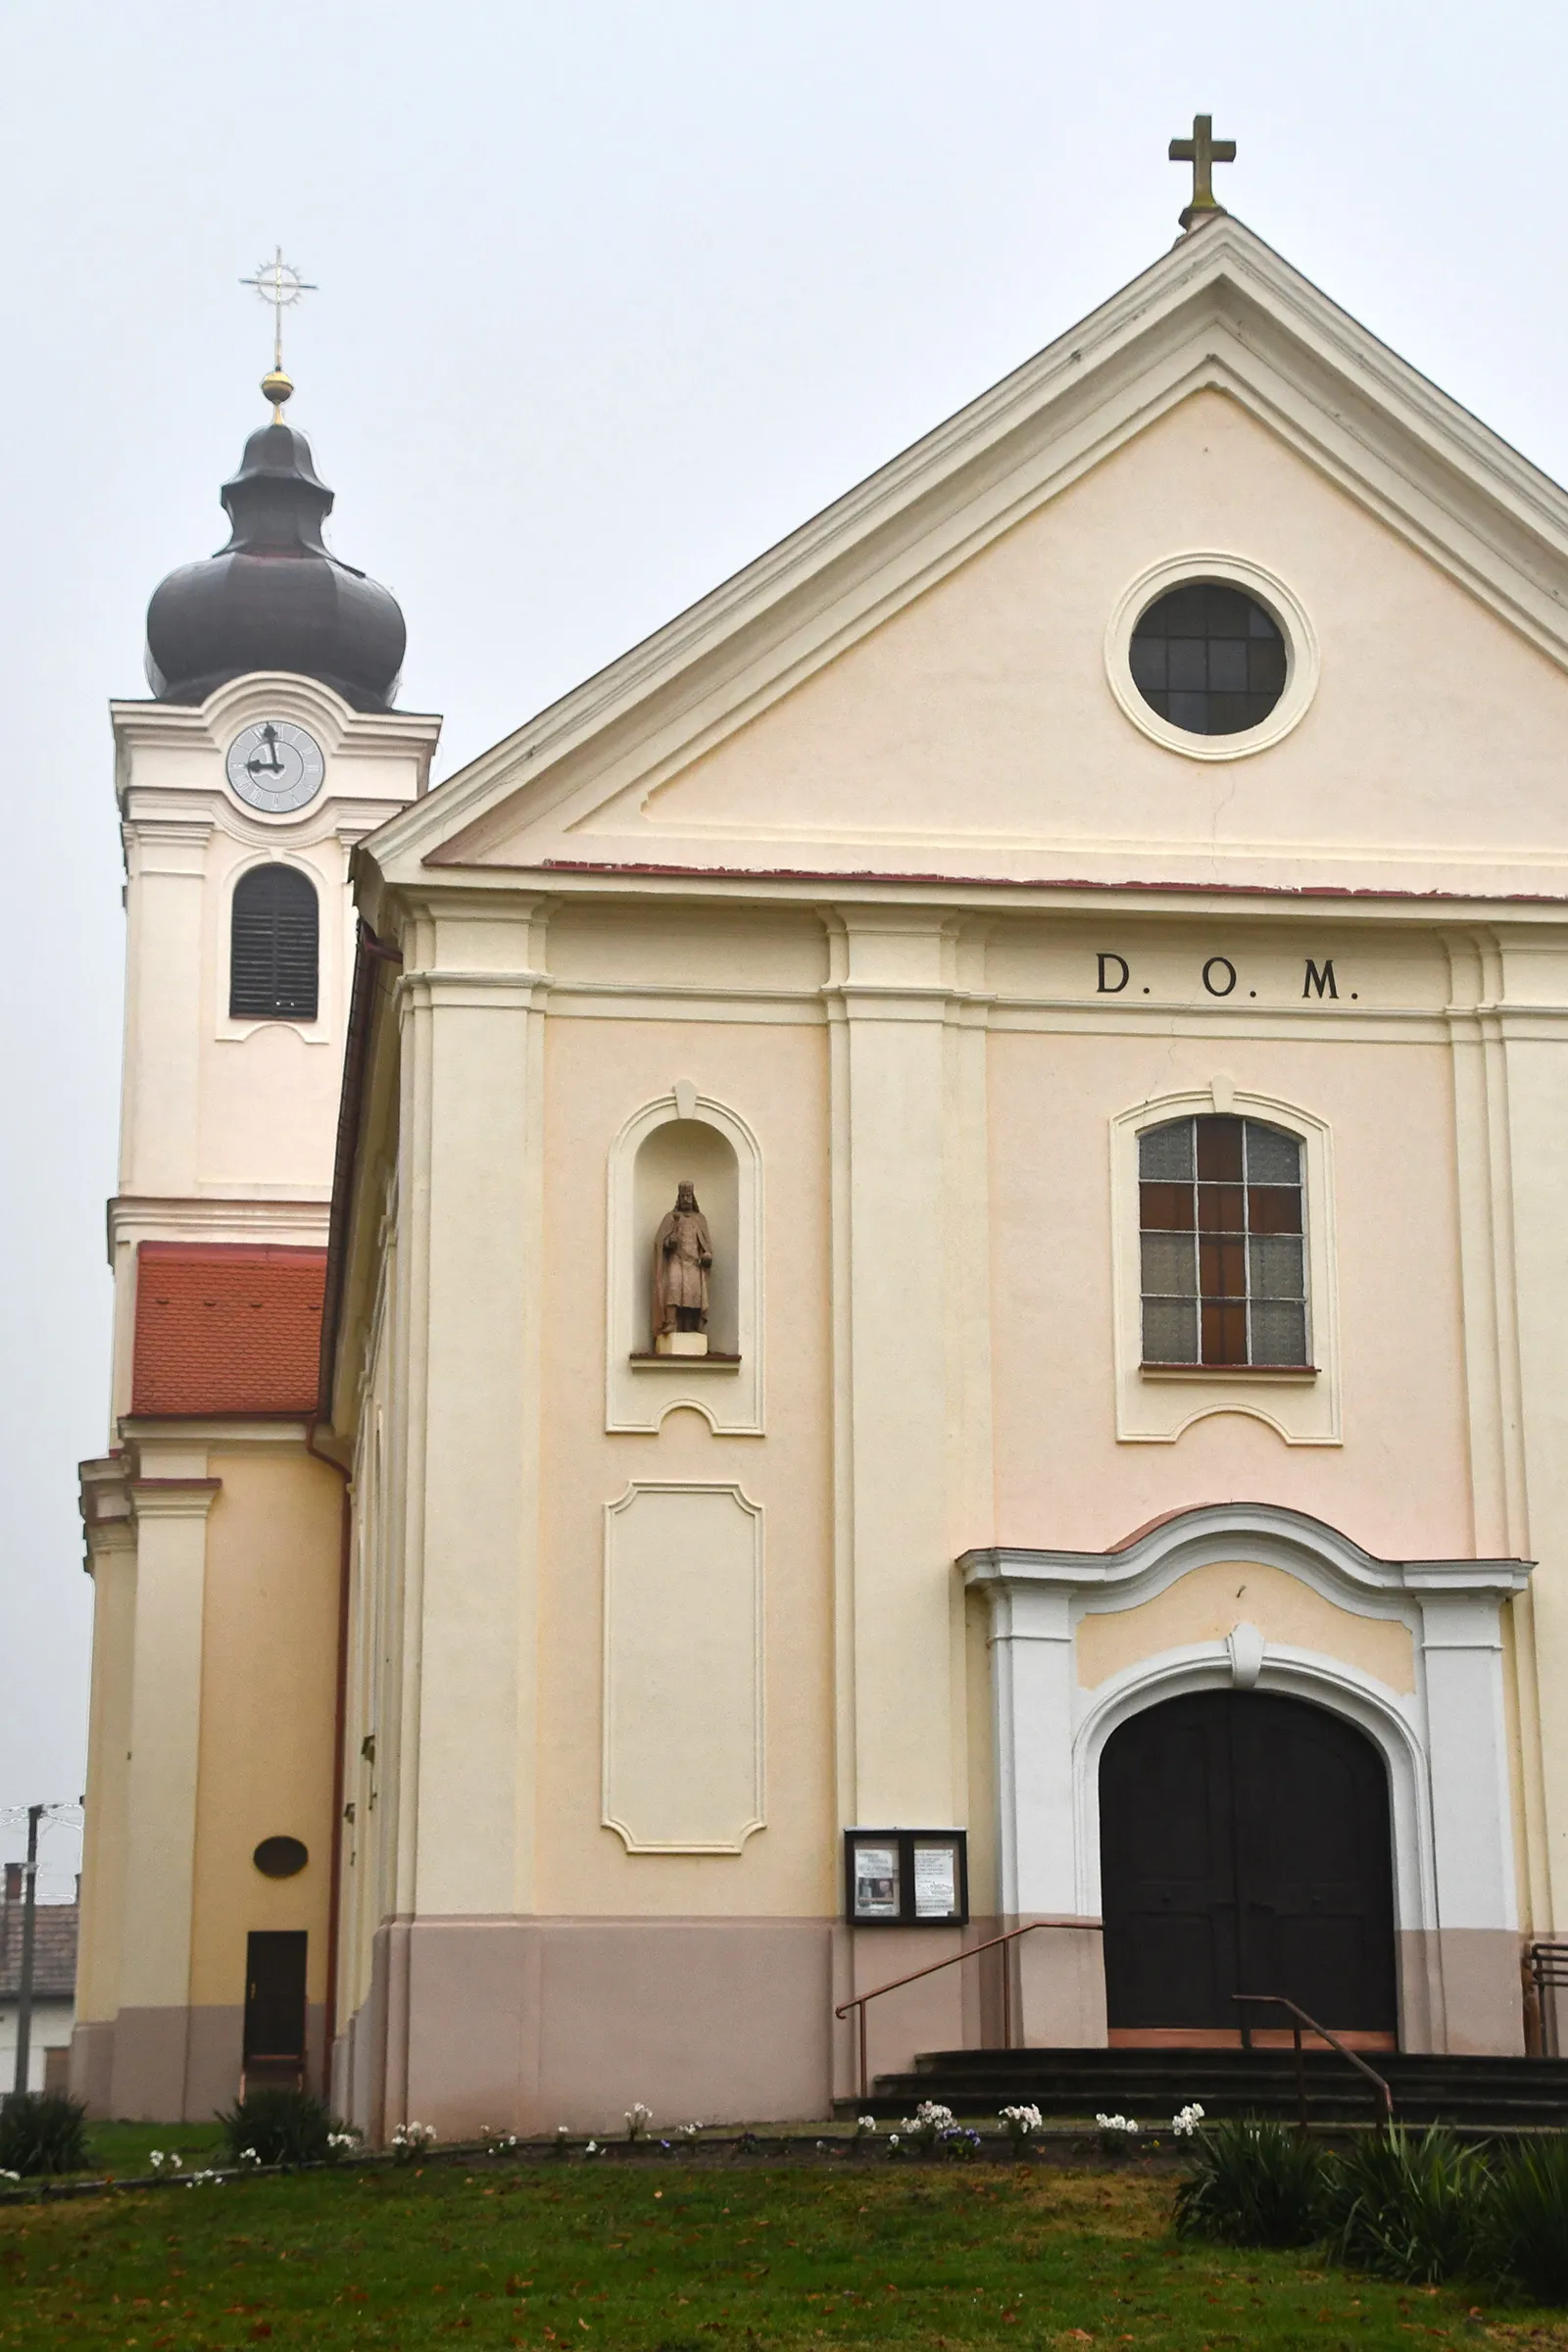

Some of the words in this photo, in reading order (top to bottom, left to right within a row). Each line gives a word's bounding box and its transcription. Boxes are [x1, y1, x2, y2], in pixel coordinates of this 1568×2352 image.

[1096, 953, 1150, 994] D.
[1201, 956, 1256, 998] O.
[1301, 958, 1359, 1000] M.
